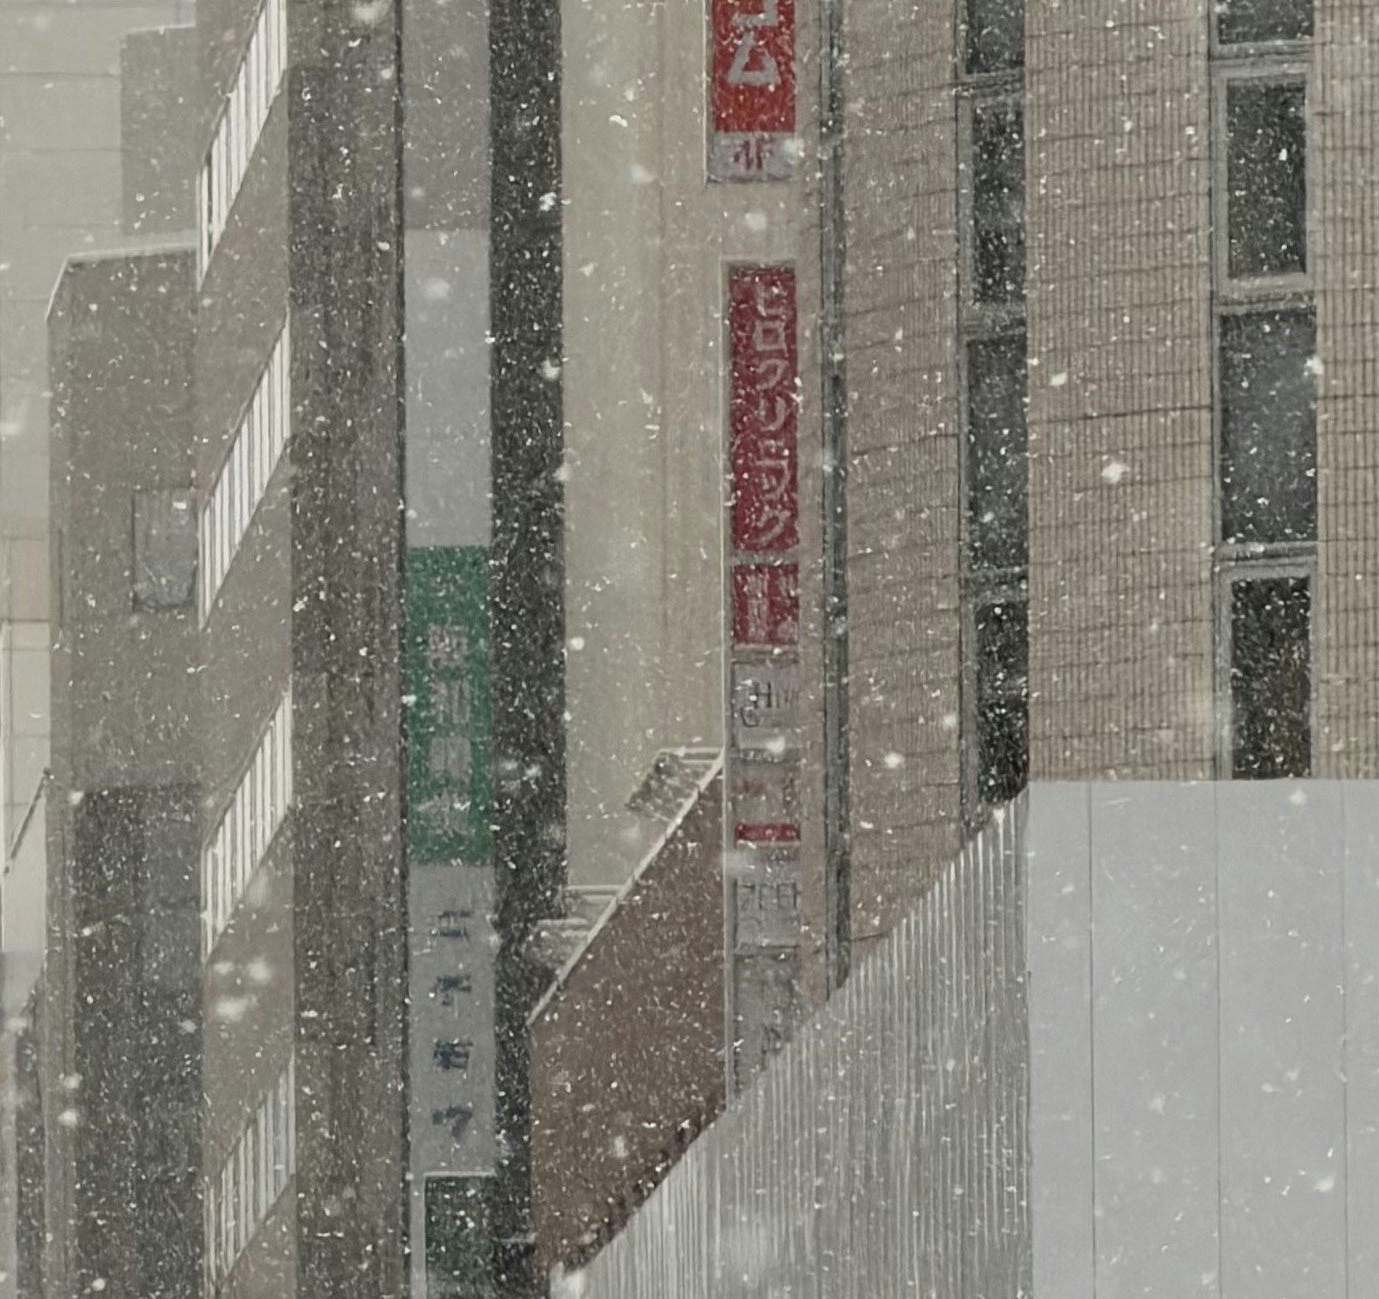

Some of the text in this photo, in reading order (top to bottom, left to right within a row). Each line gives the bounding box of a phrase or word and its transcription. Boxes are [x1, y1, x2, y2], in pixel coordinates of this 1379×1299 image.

[754, 281, 791, 548] ヒロクリニック
